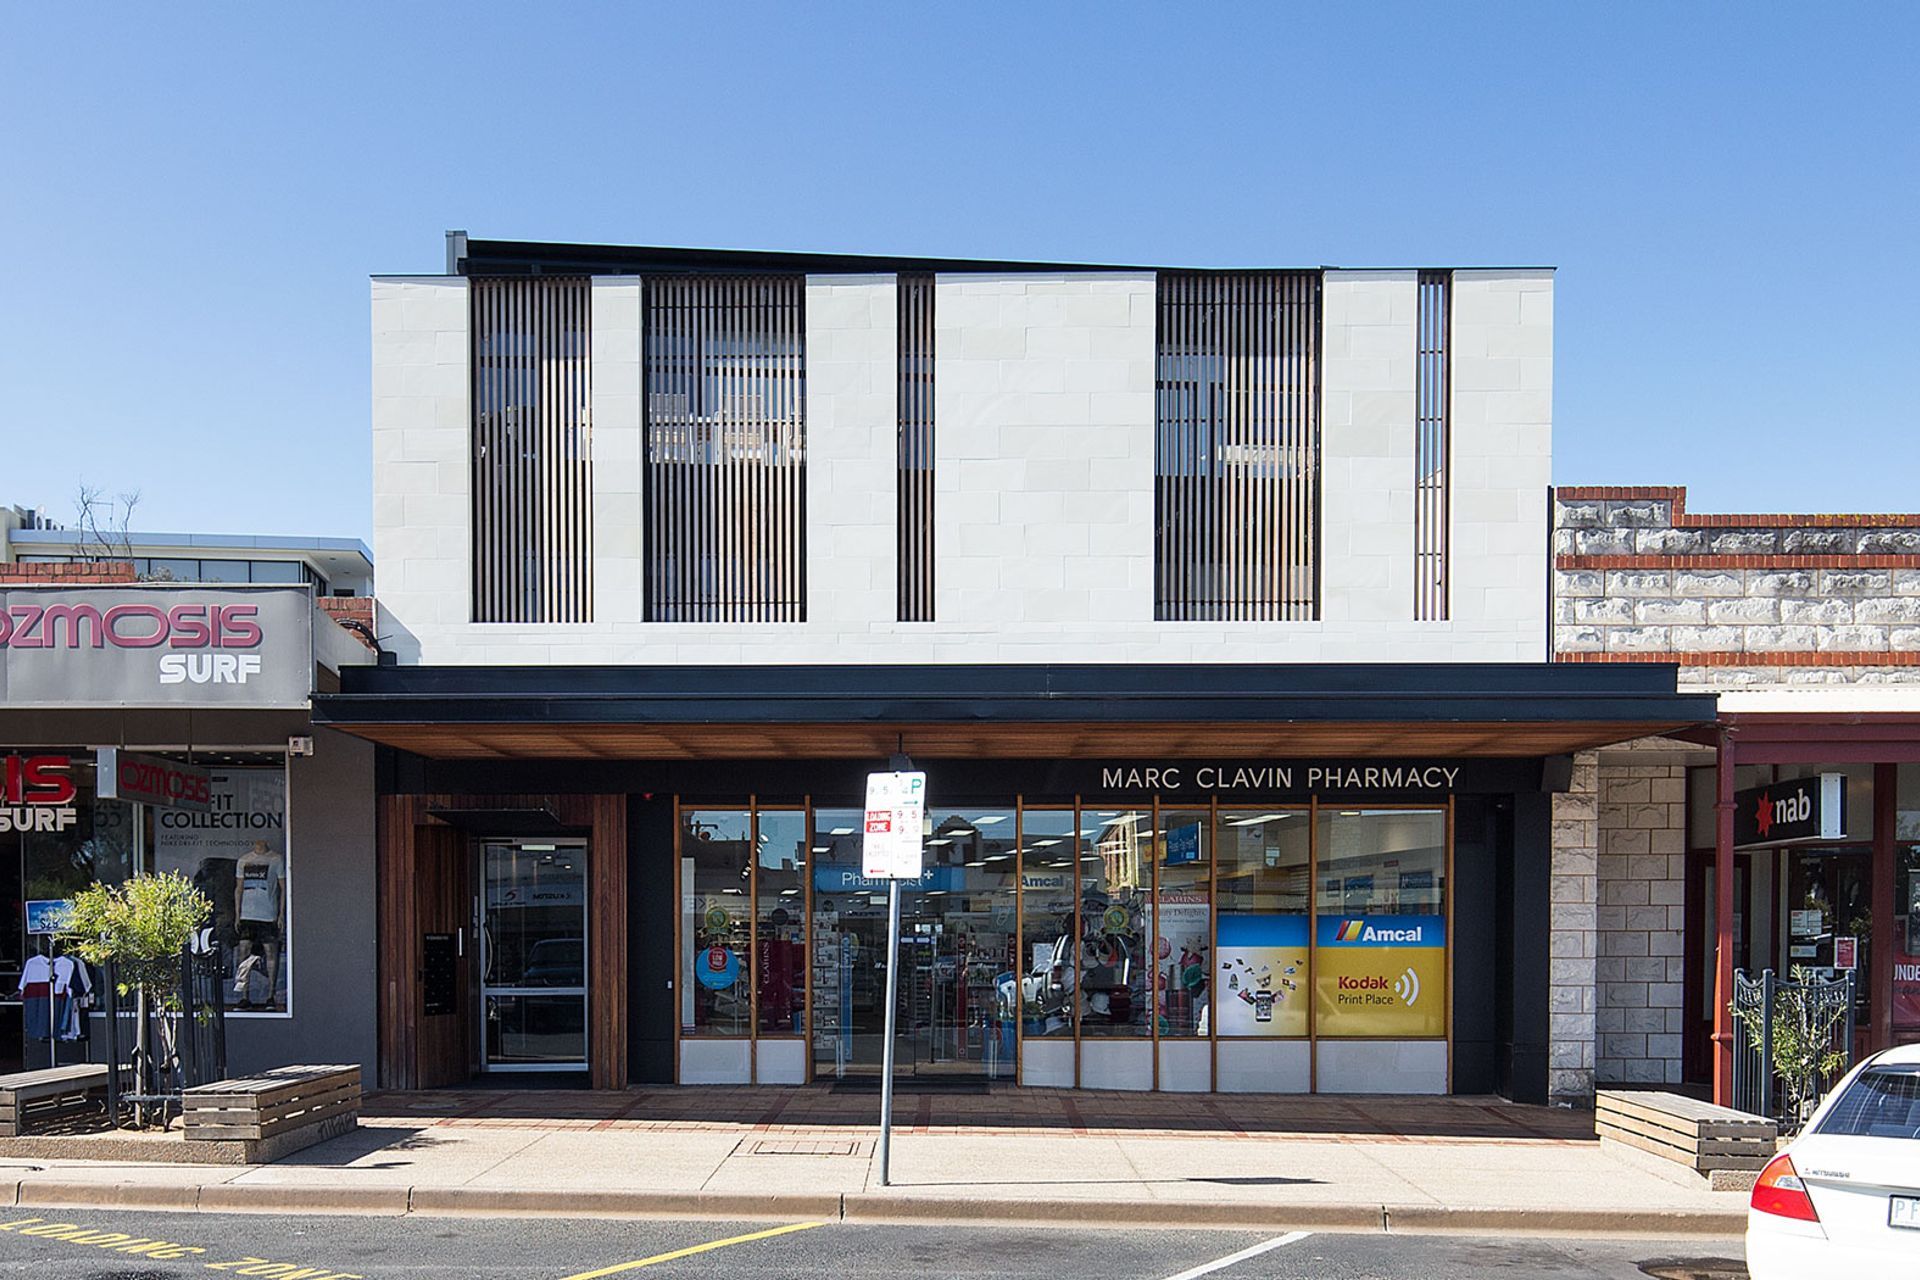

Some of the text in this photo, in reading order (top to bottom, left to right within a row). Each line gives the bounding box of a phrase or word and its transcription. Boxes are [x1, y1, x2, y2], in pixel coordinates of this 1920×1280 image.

[0, 604, 262, 648] ZMOSIS
[159, 654, 261, 684] SURF
[0, 756, 77, 805] IS
[120, 761, 209, 804] OZMOSIS
[1102, 766, 1459, 789] MARC CLAVIN PHARMACY
[1775, 788, 1811, 824] nab
[0, 808, 77, 832] SURF
[161, 812, 283, 829] COLLECTION
[1021, 875, 1064, 887] Amcal
[1159, 895, 1202, 903] LARINS
[1362, 926, 1422, 942] Amcal
[1338, 976, 1389, 990] Kodak
[1338, 993, 1394, 1005] Print Place
[0, 1218, 206, 1259] LOADING
